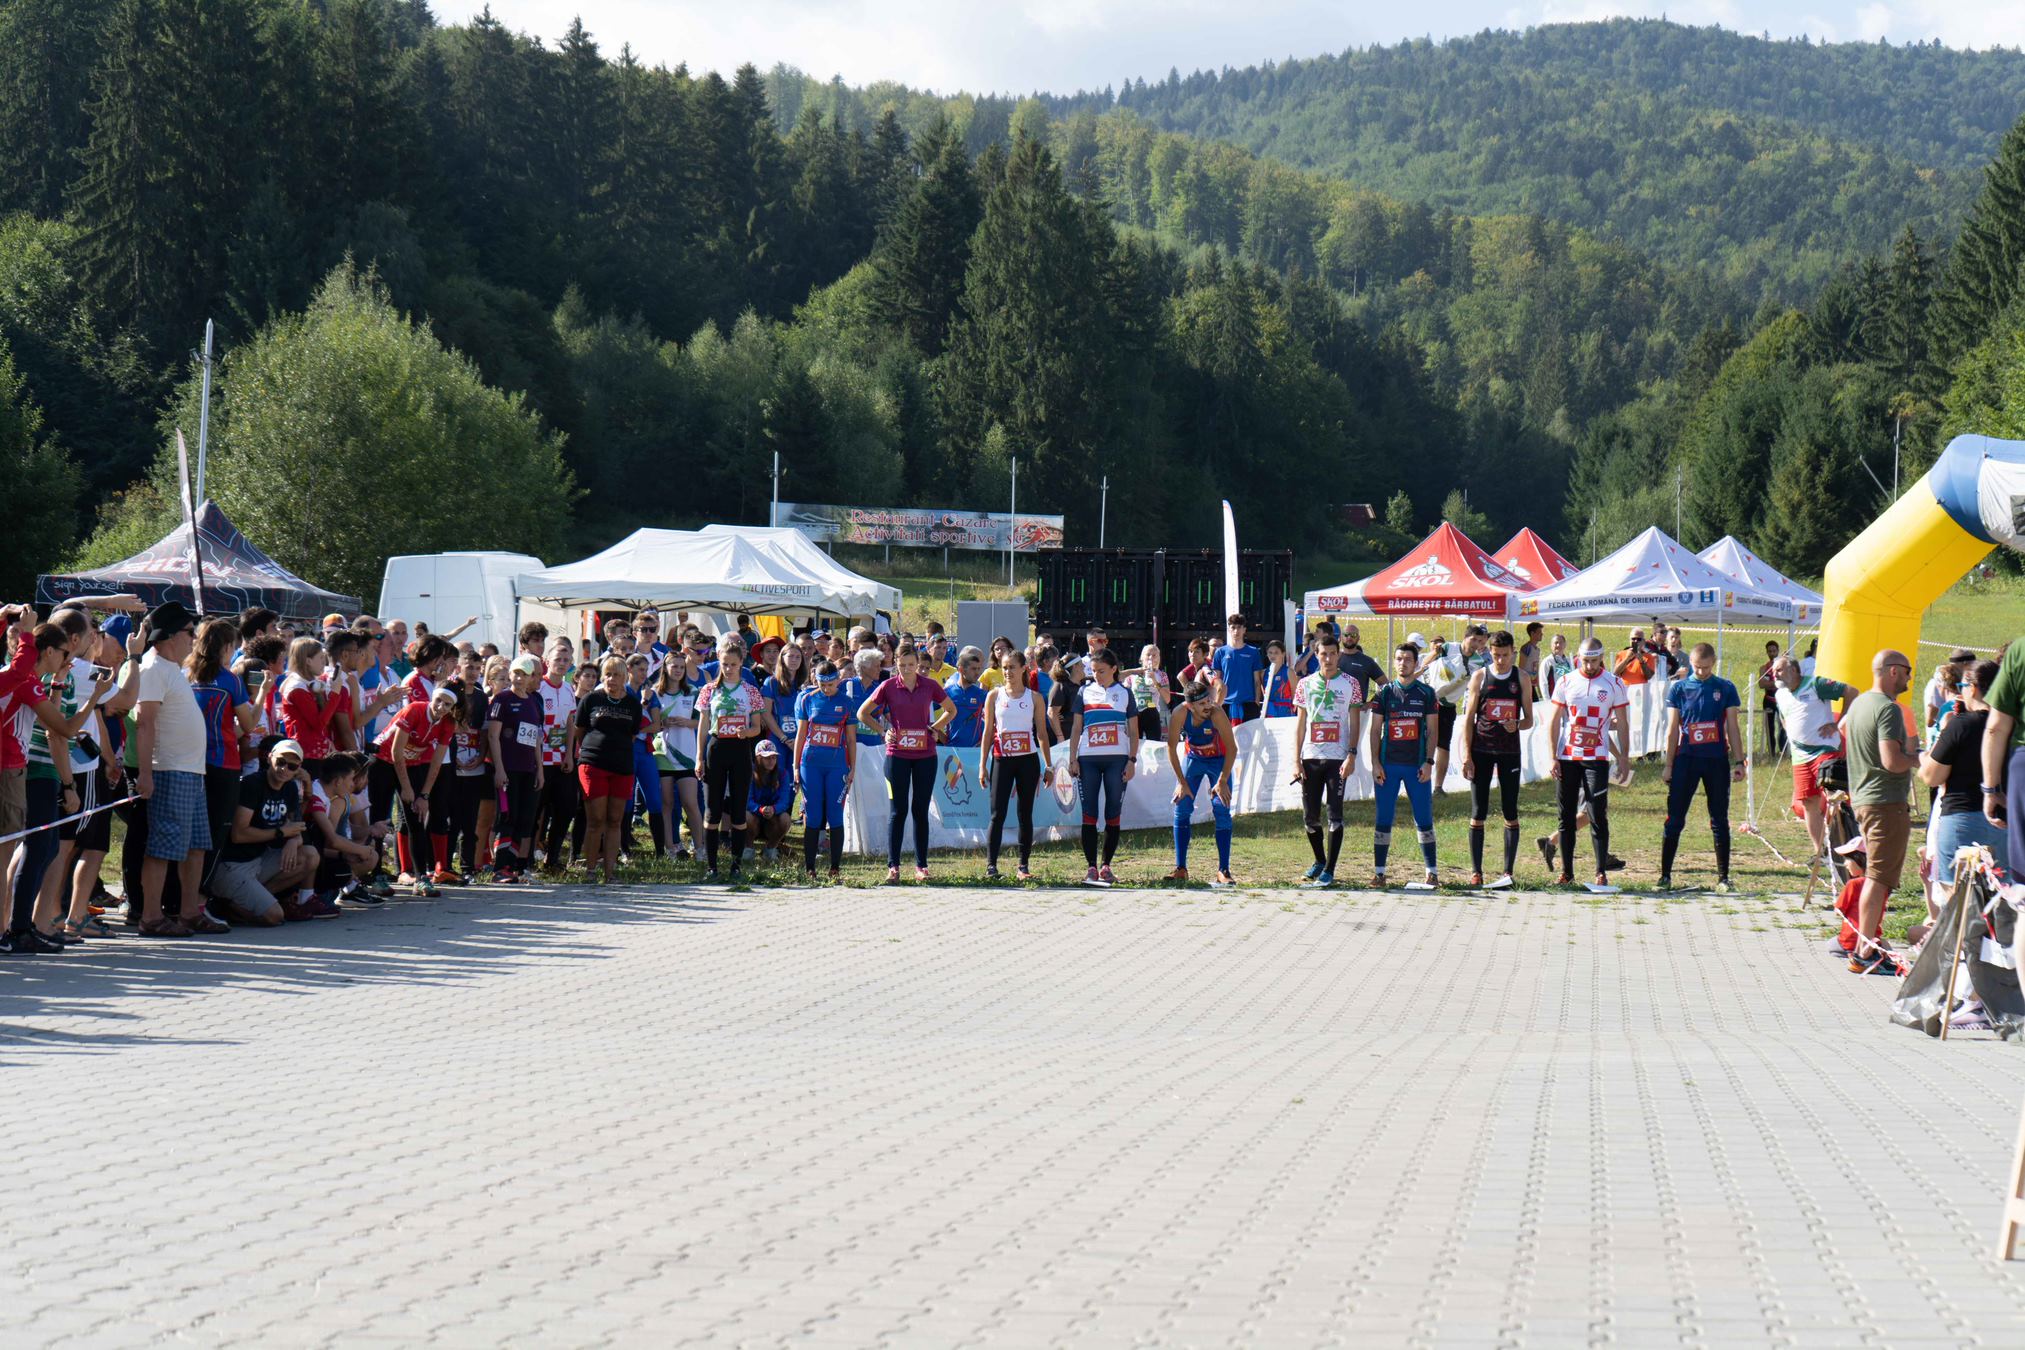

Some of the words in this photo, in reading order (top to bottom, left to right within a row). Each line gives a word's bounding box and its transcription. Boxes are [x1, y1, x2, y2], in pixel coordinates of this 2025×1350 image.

[929, 530, 997, 545] sportive
[54, 580, 74, 595] sign
[80, 580, 126, 592] yourself
[1386, 574, 1455, 590] SKOL
[1320, 597, 1346, 607] SKOL
[1631, 596, 1673, 604] ORIENTARE
[1491, 705, 1502, 718] 4
[782, 721, 797, 734] 63
[1393, 726, 1404, 739] 3
[1315, 730, 1325, 741] 2
[1573, 733, 1584, 745] 5
[1693, 730, 1704, 742] 6
[261, 803, 288, 820] CUP
